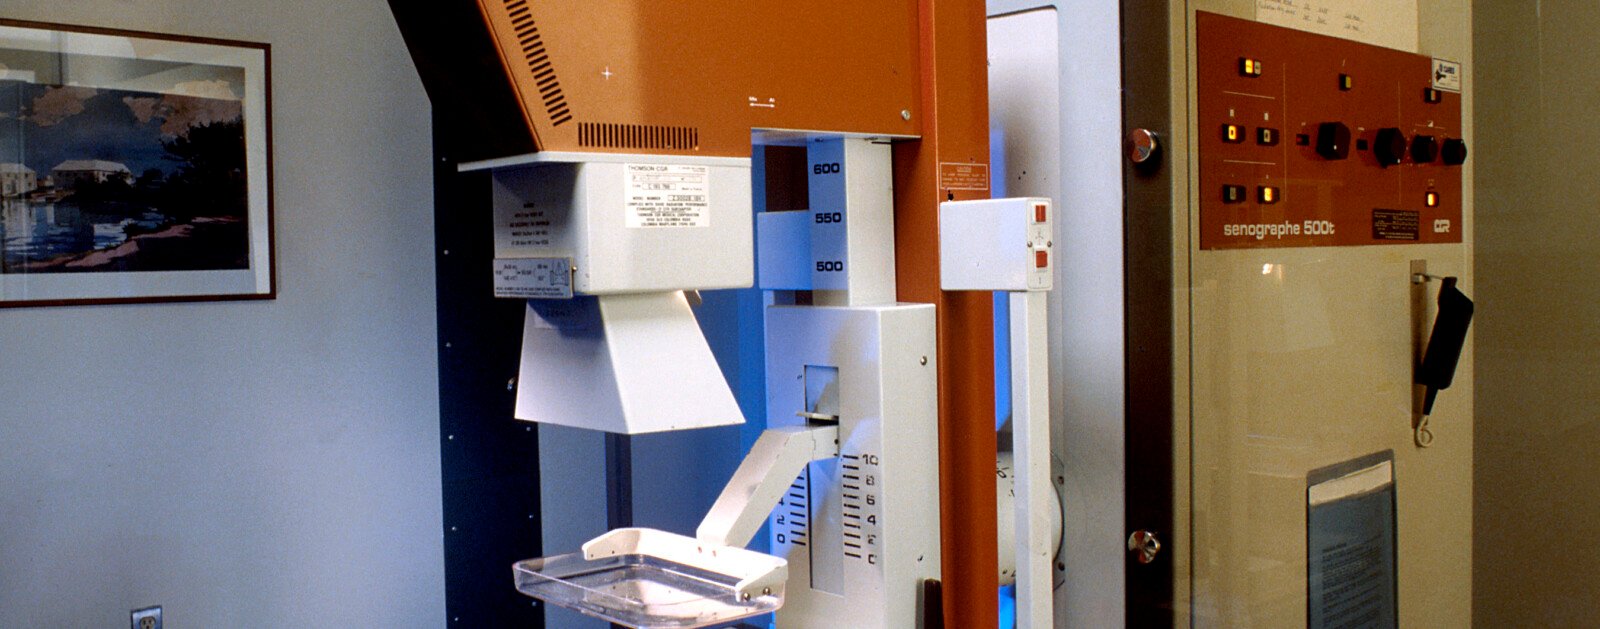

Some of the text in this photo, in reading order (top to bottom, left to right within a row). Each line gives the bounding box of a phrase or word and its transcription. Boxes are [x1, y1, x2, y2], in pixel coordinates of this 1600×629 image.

[814, 163, 840, 174] 600
[815, 212, 842, 223] 550
[1224, 220, 1336, 240] senographe 500t
[816, 261, 843, 272] 500
[862, 454, 879, 466] 10
[866, 495, 876, 506] 6
[776, 515, 785, 525] 2
[867, 515, 876, 525] 4
[776, 533, 786, 544] 0
